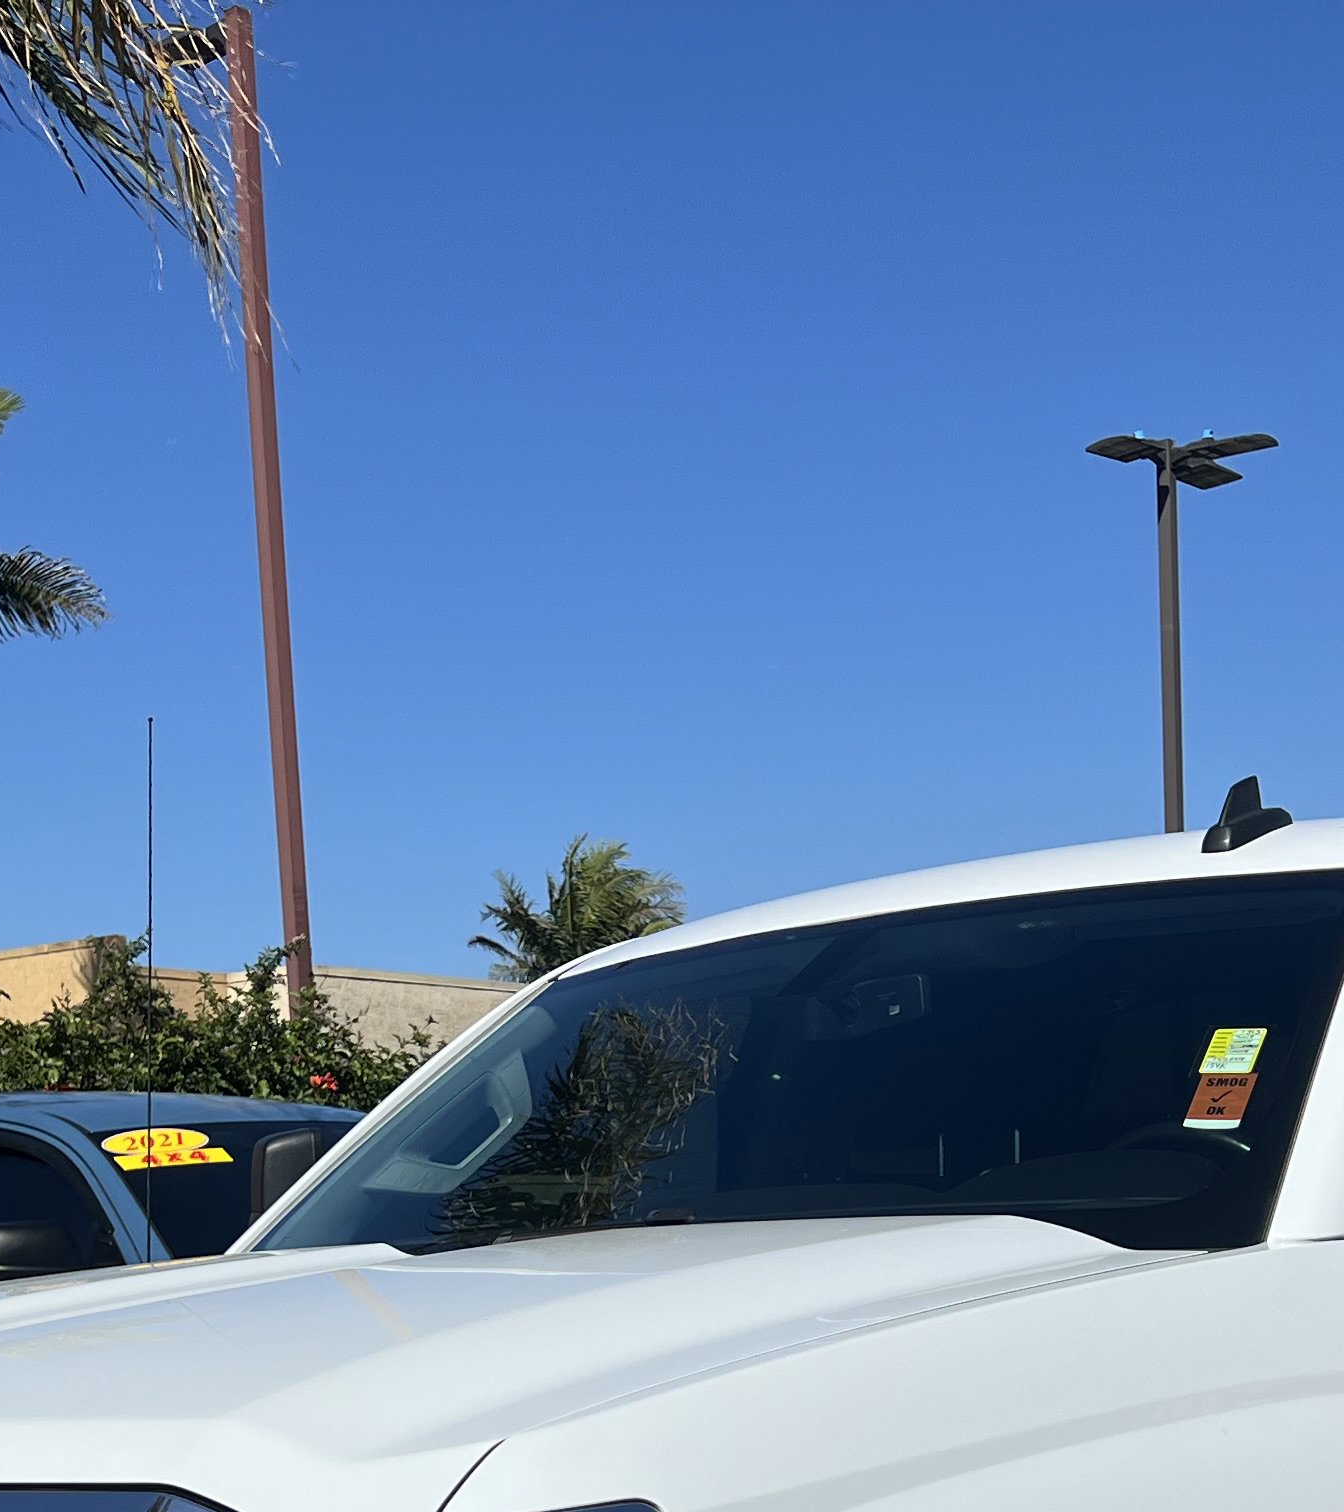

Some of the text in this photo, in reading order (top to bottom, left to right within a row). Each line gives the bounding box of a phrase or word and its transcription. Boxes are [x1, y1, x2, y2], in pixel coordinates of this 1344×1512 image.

[1206, 1077, 1248, 1087] SMOG
[1206, 1106, 1225, 1115] OK
[124, 1132, 184, 1151] 2021
